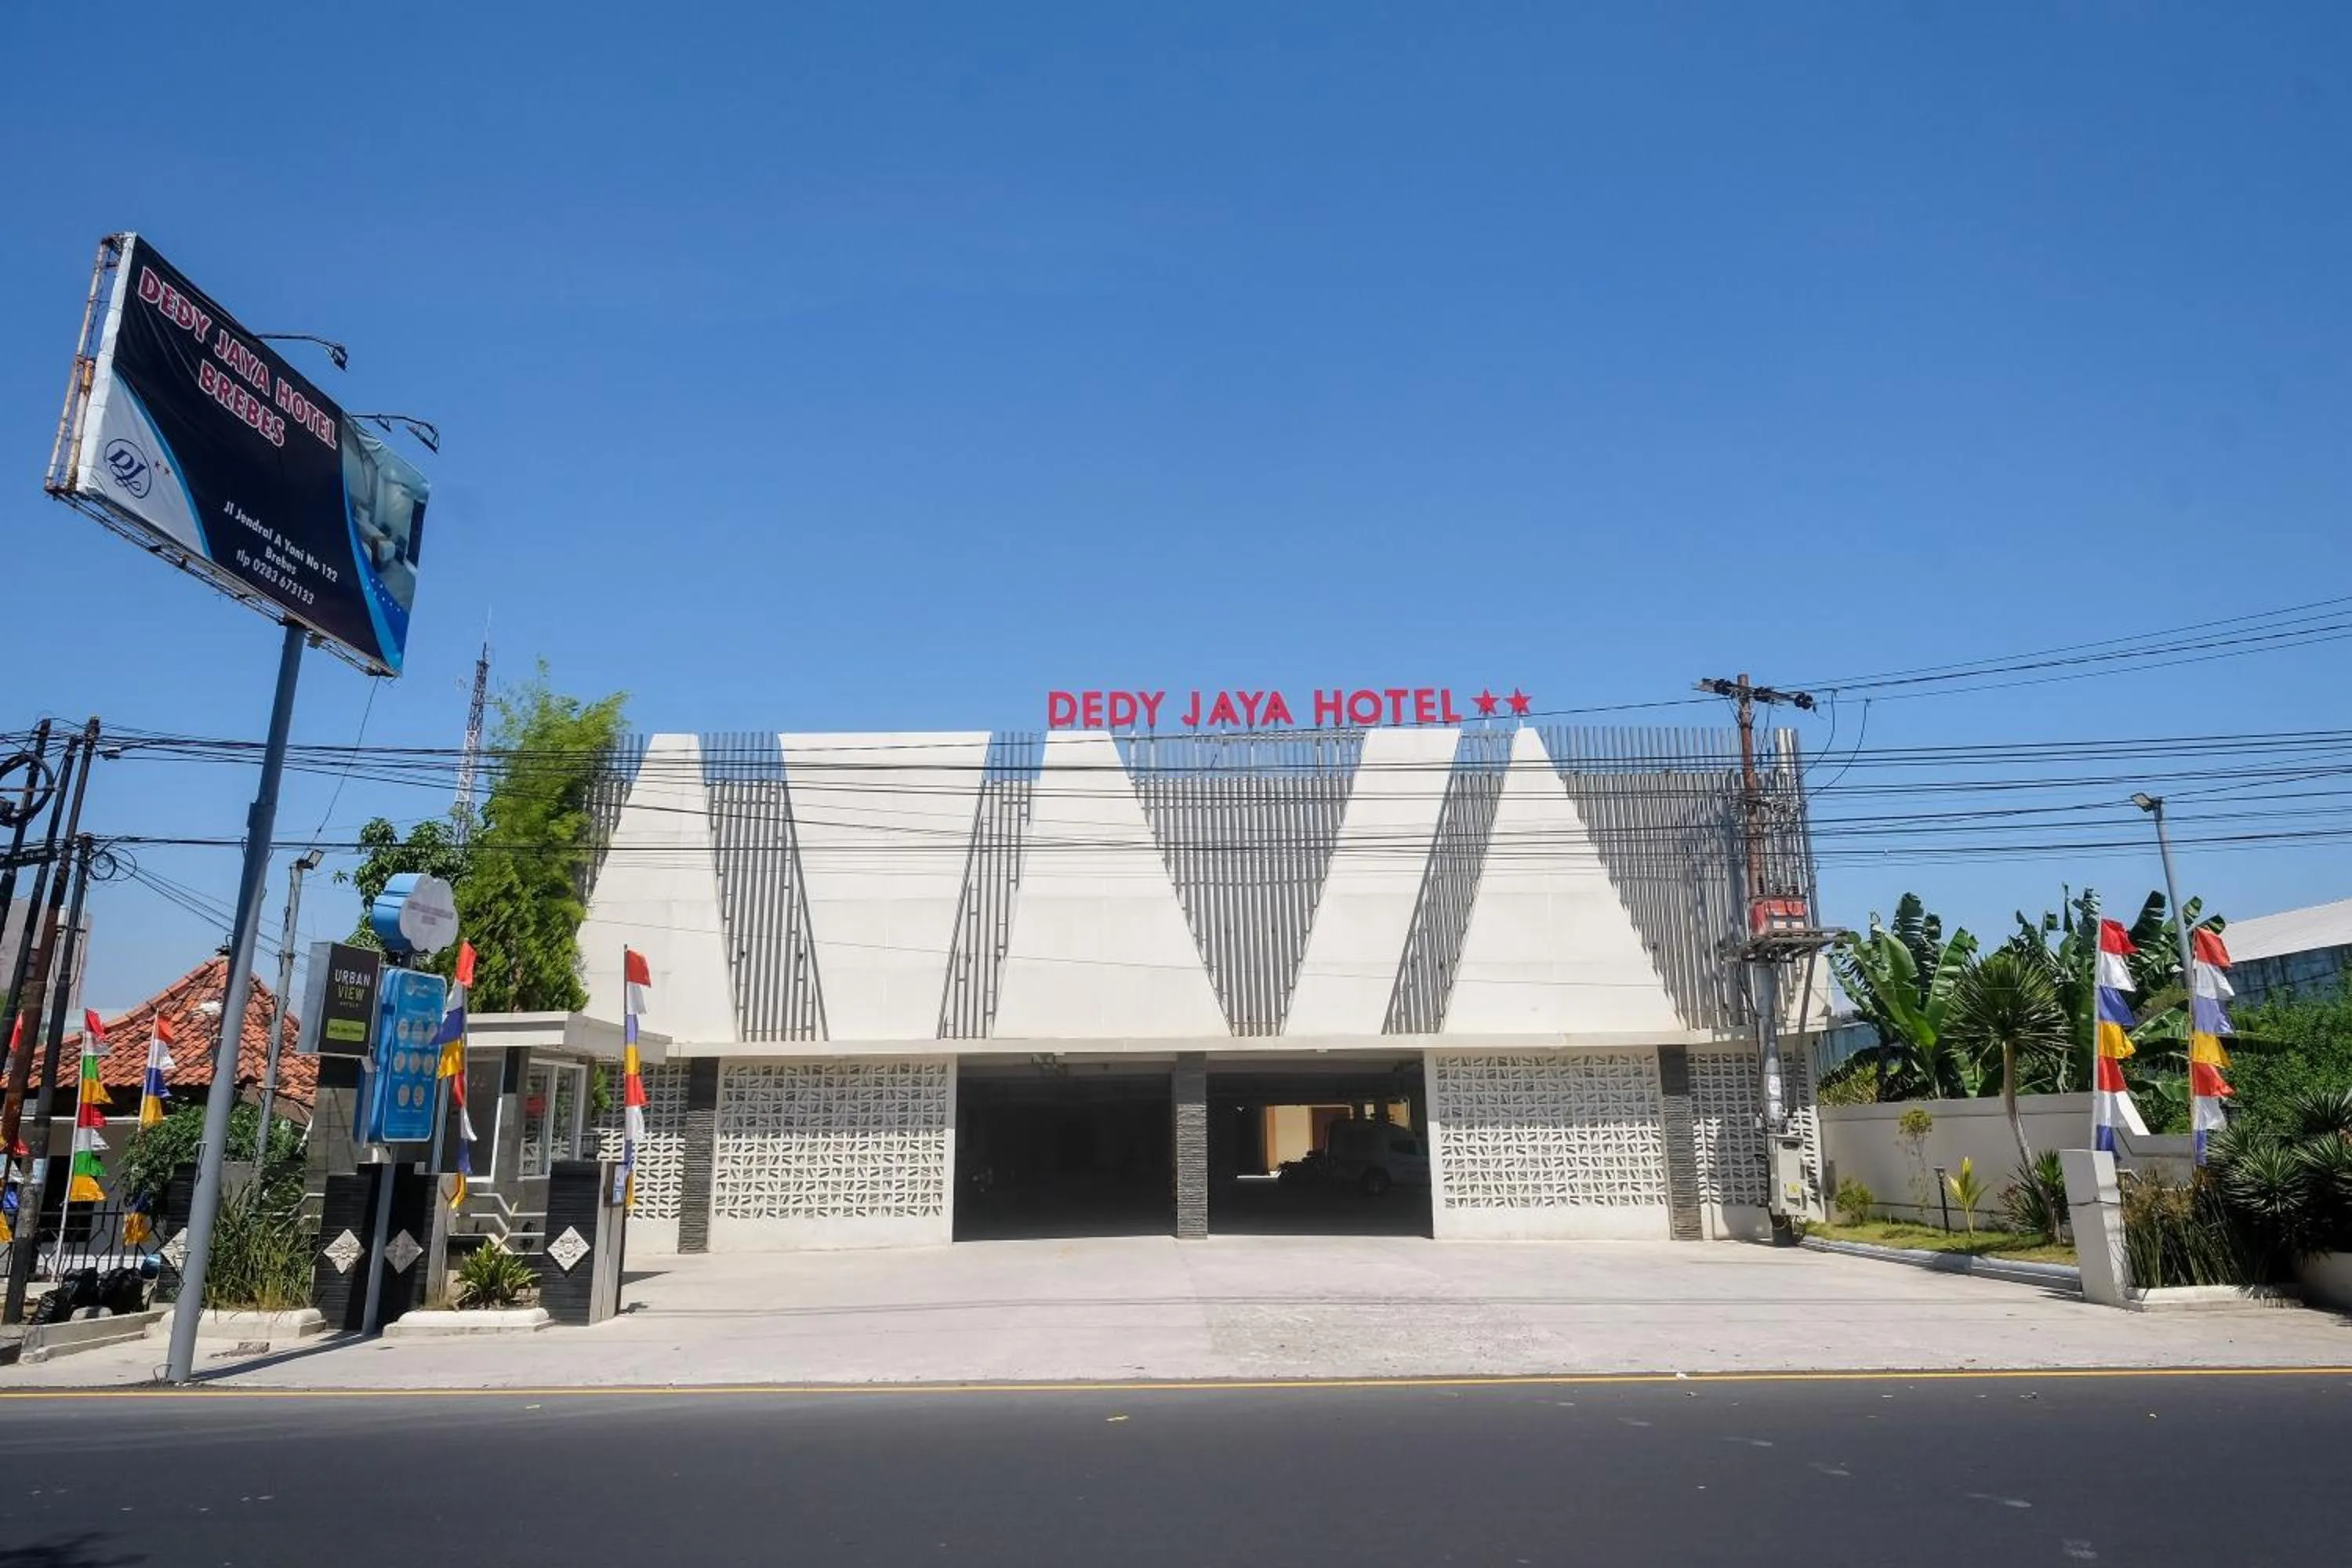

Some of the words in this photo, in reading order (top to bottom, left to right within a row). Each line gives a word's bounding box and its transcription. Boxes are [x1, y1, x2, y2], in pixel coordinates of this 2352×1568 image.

[138, 266, 212, 343] DEDY
[214, 328, 270, 397] JAYA
[275, 377, 337, 450] HOTEL
[198, 358, 285, 447] BREBES
[223, 501, 234, 515] Jl
[235, 508, 274, 540] Jendral
[274, 533, 282, 547] A
[285, 539, 305, 561] Yani
[306, 553, 319, 570] No
[322, 564, 338, 583] 122
[236, 550, 250, 568] tlp
[252, 558, 278, 583] 0283
[265, 546, 297, 575] Brebes
[1047, 691, 1167, 726] DEDY
[1181, 691, 1295, 726] JAYA
[1313, 688, 1462, 724] HOTEL
[335, 968, 371, 988] URBAN
[338, 984, 365, 1001] VIEW
